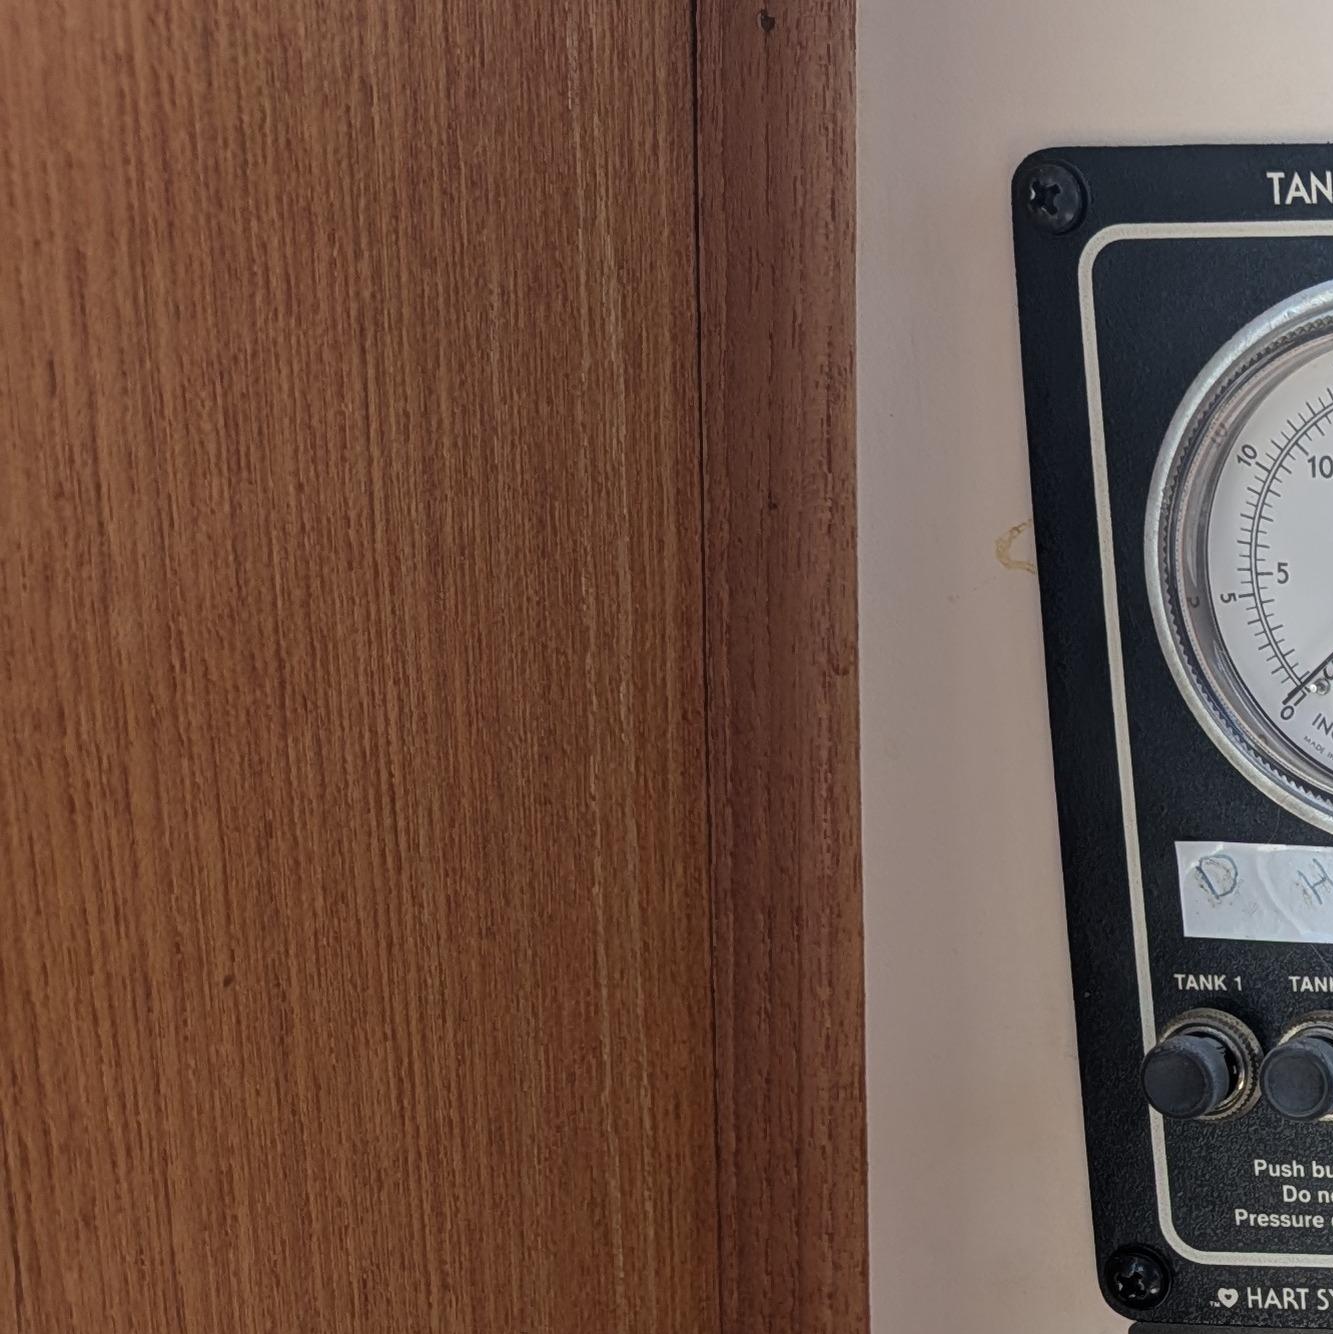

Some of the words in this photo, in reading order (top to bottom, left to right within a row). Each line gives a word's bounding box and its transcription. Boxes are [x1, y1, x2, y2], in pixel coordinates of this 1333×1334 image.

[1236, 443, 1258, 466] 10
[1276, 561, 1289, 585] 5
[1220, 592, 1237, 604] 5
[1280, 705, 1295, 721] 0
[1196, 854, 1239, 900] D
[1173, 973, 1228, 991] TANK
[1233, 976, 1243, 991] 1
[1253, 1159, 1305, 1178] Push
[1282, 1185, 1311, 1203] Do
[1234, 1208, 1325, 1228] Pressure
[1246, 1286, 1309, 1310] HART
